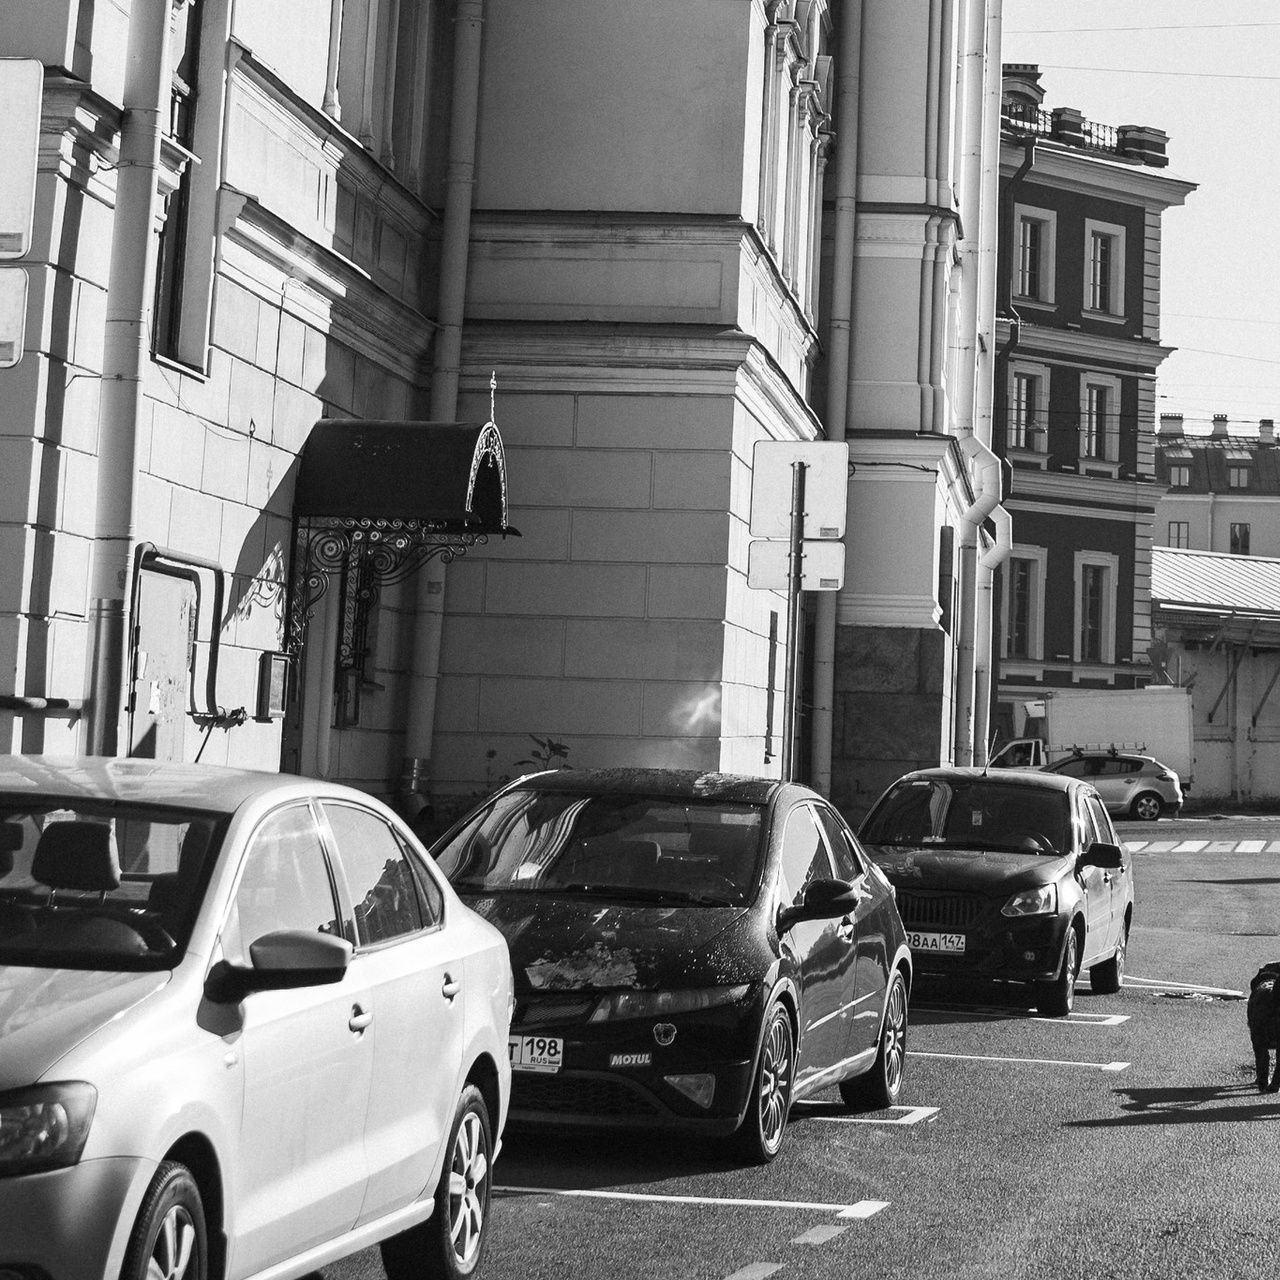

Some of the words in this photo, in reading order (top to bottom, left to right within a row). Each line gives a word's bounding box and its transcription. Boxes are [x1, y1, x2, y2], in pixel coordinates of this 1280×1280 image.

[941, 935, 962, 947] 147
[525, 1037, 558, 1057] 198
[530, 1056, 548, 1064] RUS
[611, 1053, 651, 1065] MOTUL
